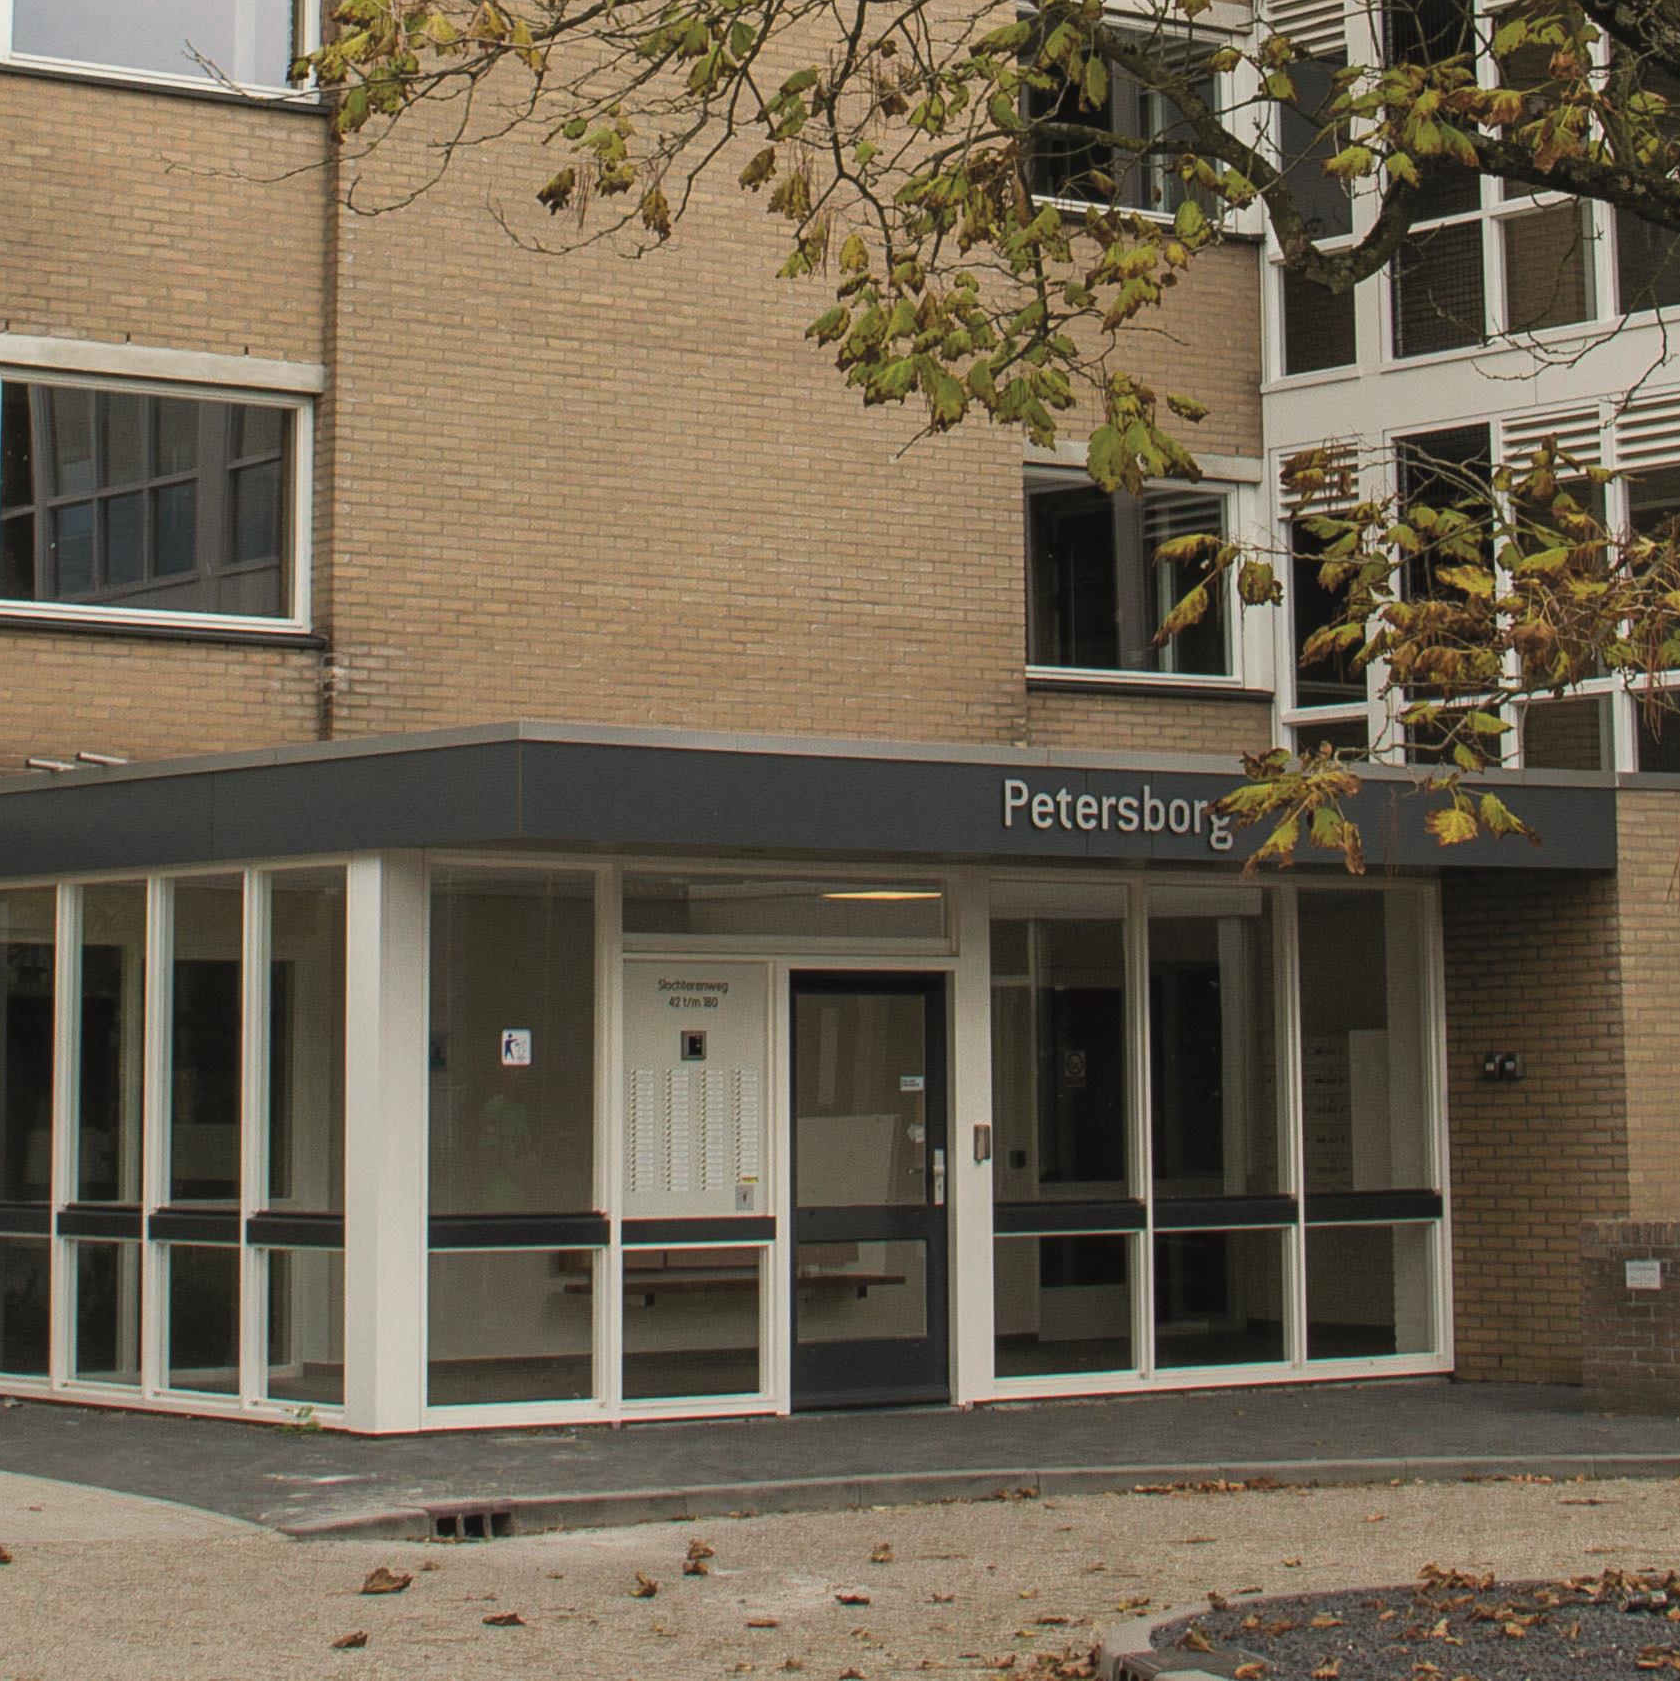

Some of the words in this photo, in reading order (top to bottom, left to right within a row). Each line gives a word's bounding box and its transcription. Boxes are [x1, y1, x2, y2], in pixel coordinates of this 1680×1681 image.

[1003, 779, 1233, 850] Petersborg
[658, 979, 729, 994] Slochterenweg
[668, 996, 681, 1008] 42
